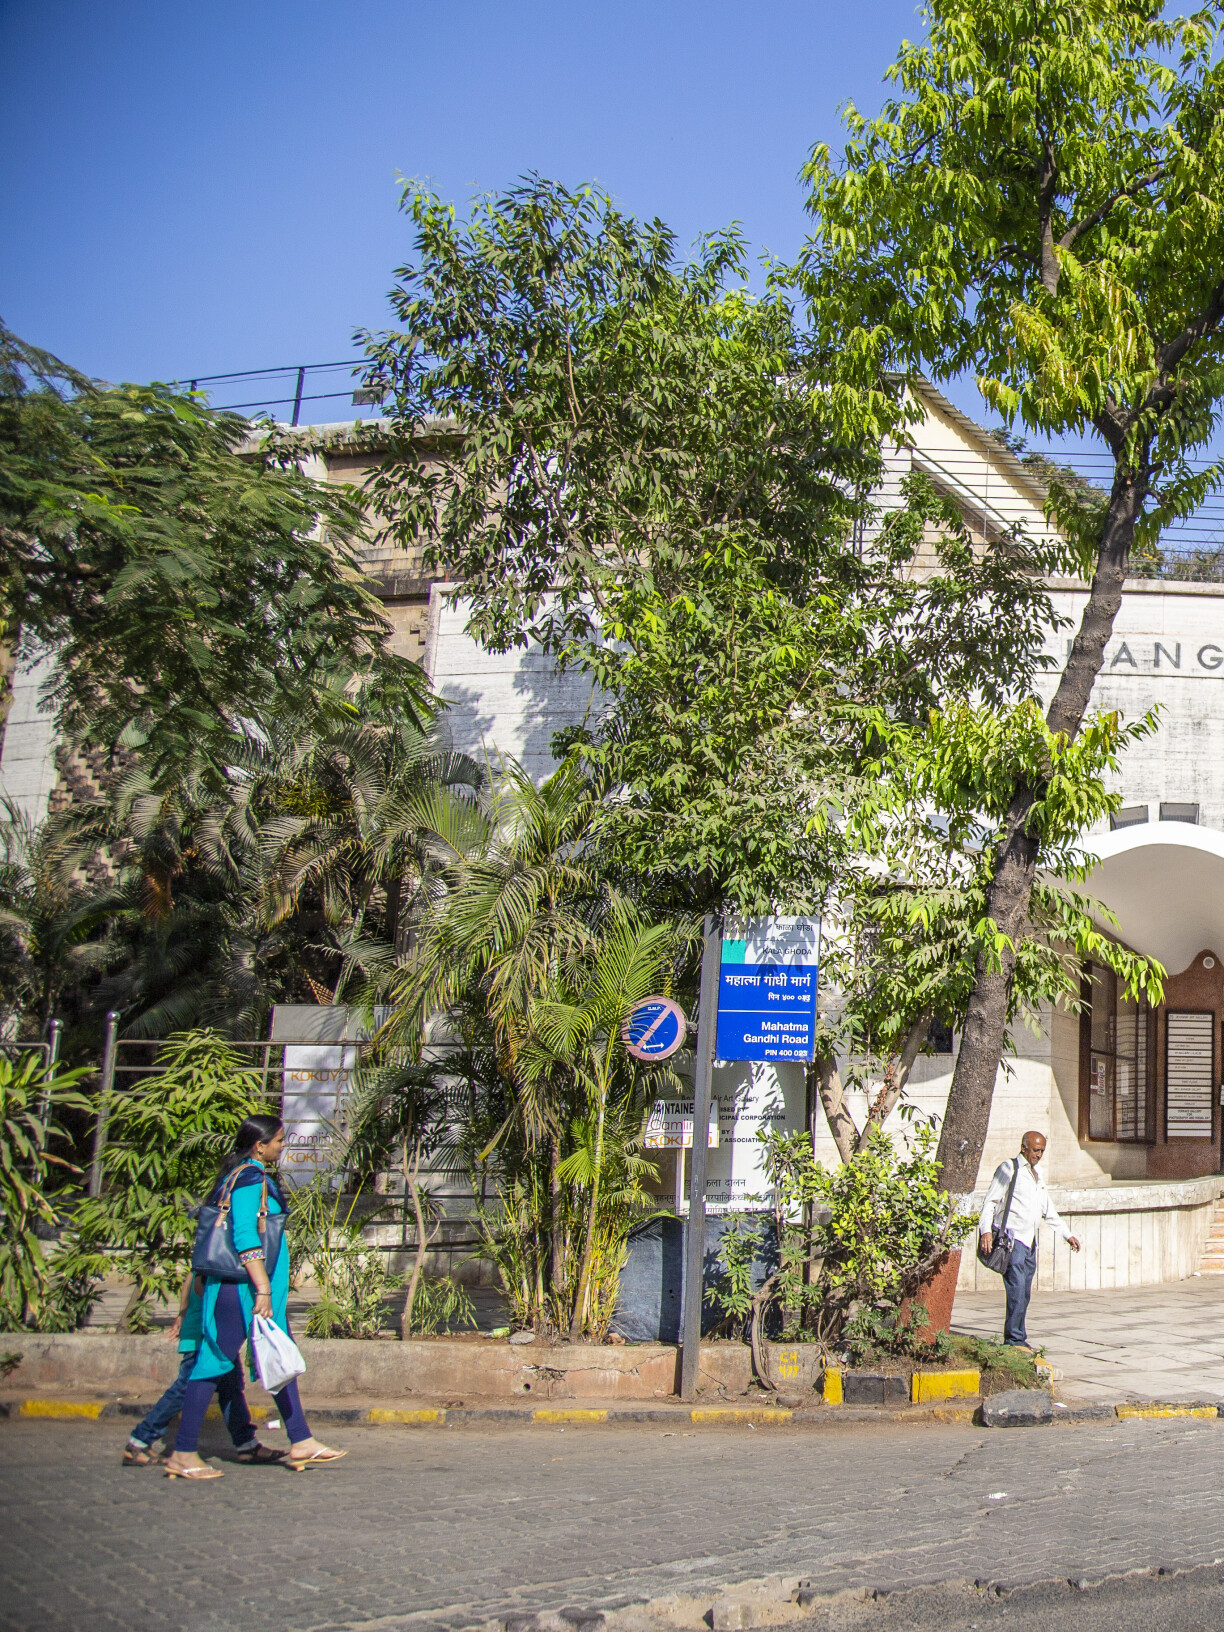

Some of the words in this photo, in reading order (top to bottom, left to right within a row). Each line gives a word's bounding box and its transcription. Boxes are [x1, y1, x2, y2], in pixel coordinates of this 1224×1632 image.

[725, 975, 761, 987] महात्मा
[763, 972, 788, 987] गांधी
[790, 973, 811, 987] मार्ग
[768, 992, 780, 1001] पिन
[761, 1021, 809, 1031] Mahatma
[743, 1033, 779, 1043] Gandhi
[781, 1034, 809, 1044] Road
[652, 1103, 694, 1115] AINTAINE
[779, 1363, 800, 1380] 477
